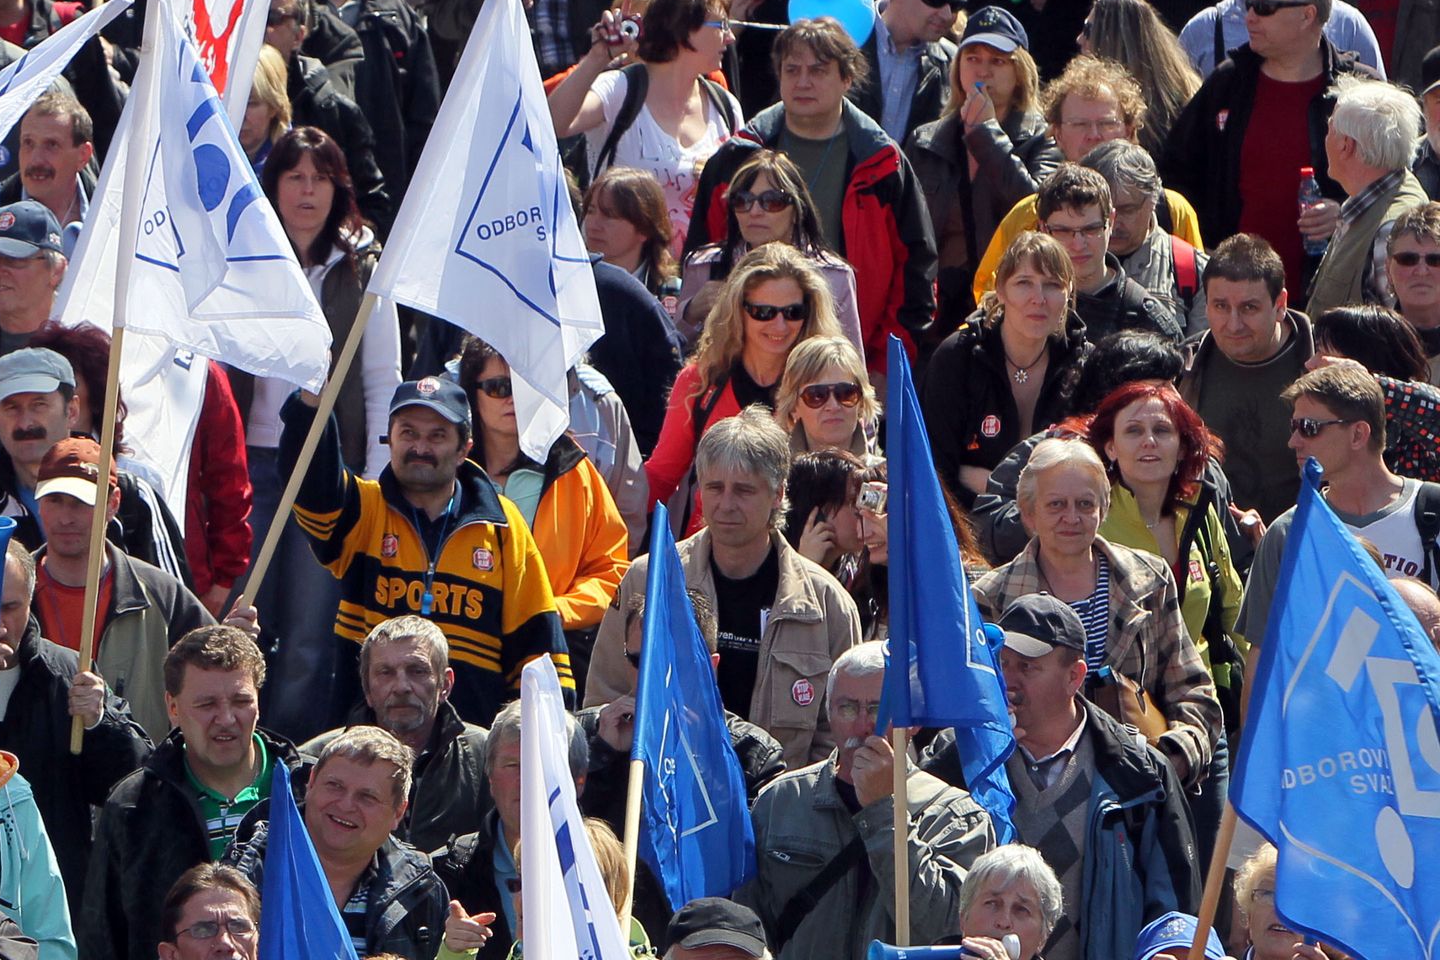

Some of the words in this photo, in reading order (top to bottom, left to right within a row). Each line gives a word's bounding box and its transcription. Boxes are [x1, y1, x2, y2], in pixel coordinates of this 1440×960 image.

[477, 206, 542, 241] ODBOR
[375, 574, 484, 620] SPORTS
[1282, 748, 1390, 790] DBOROV
